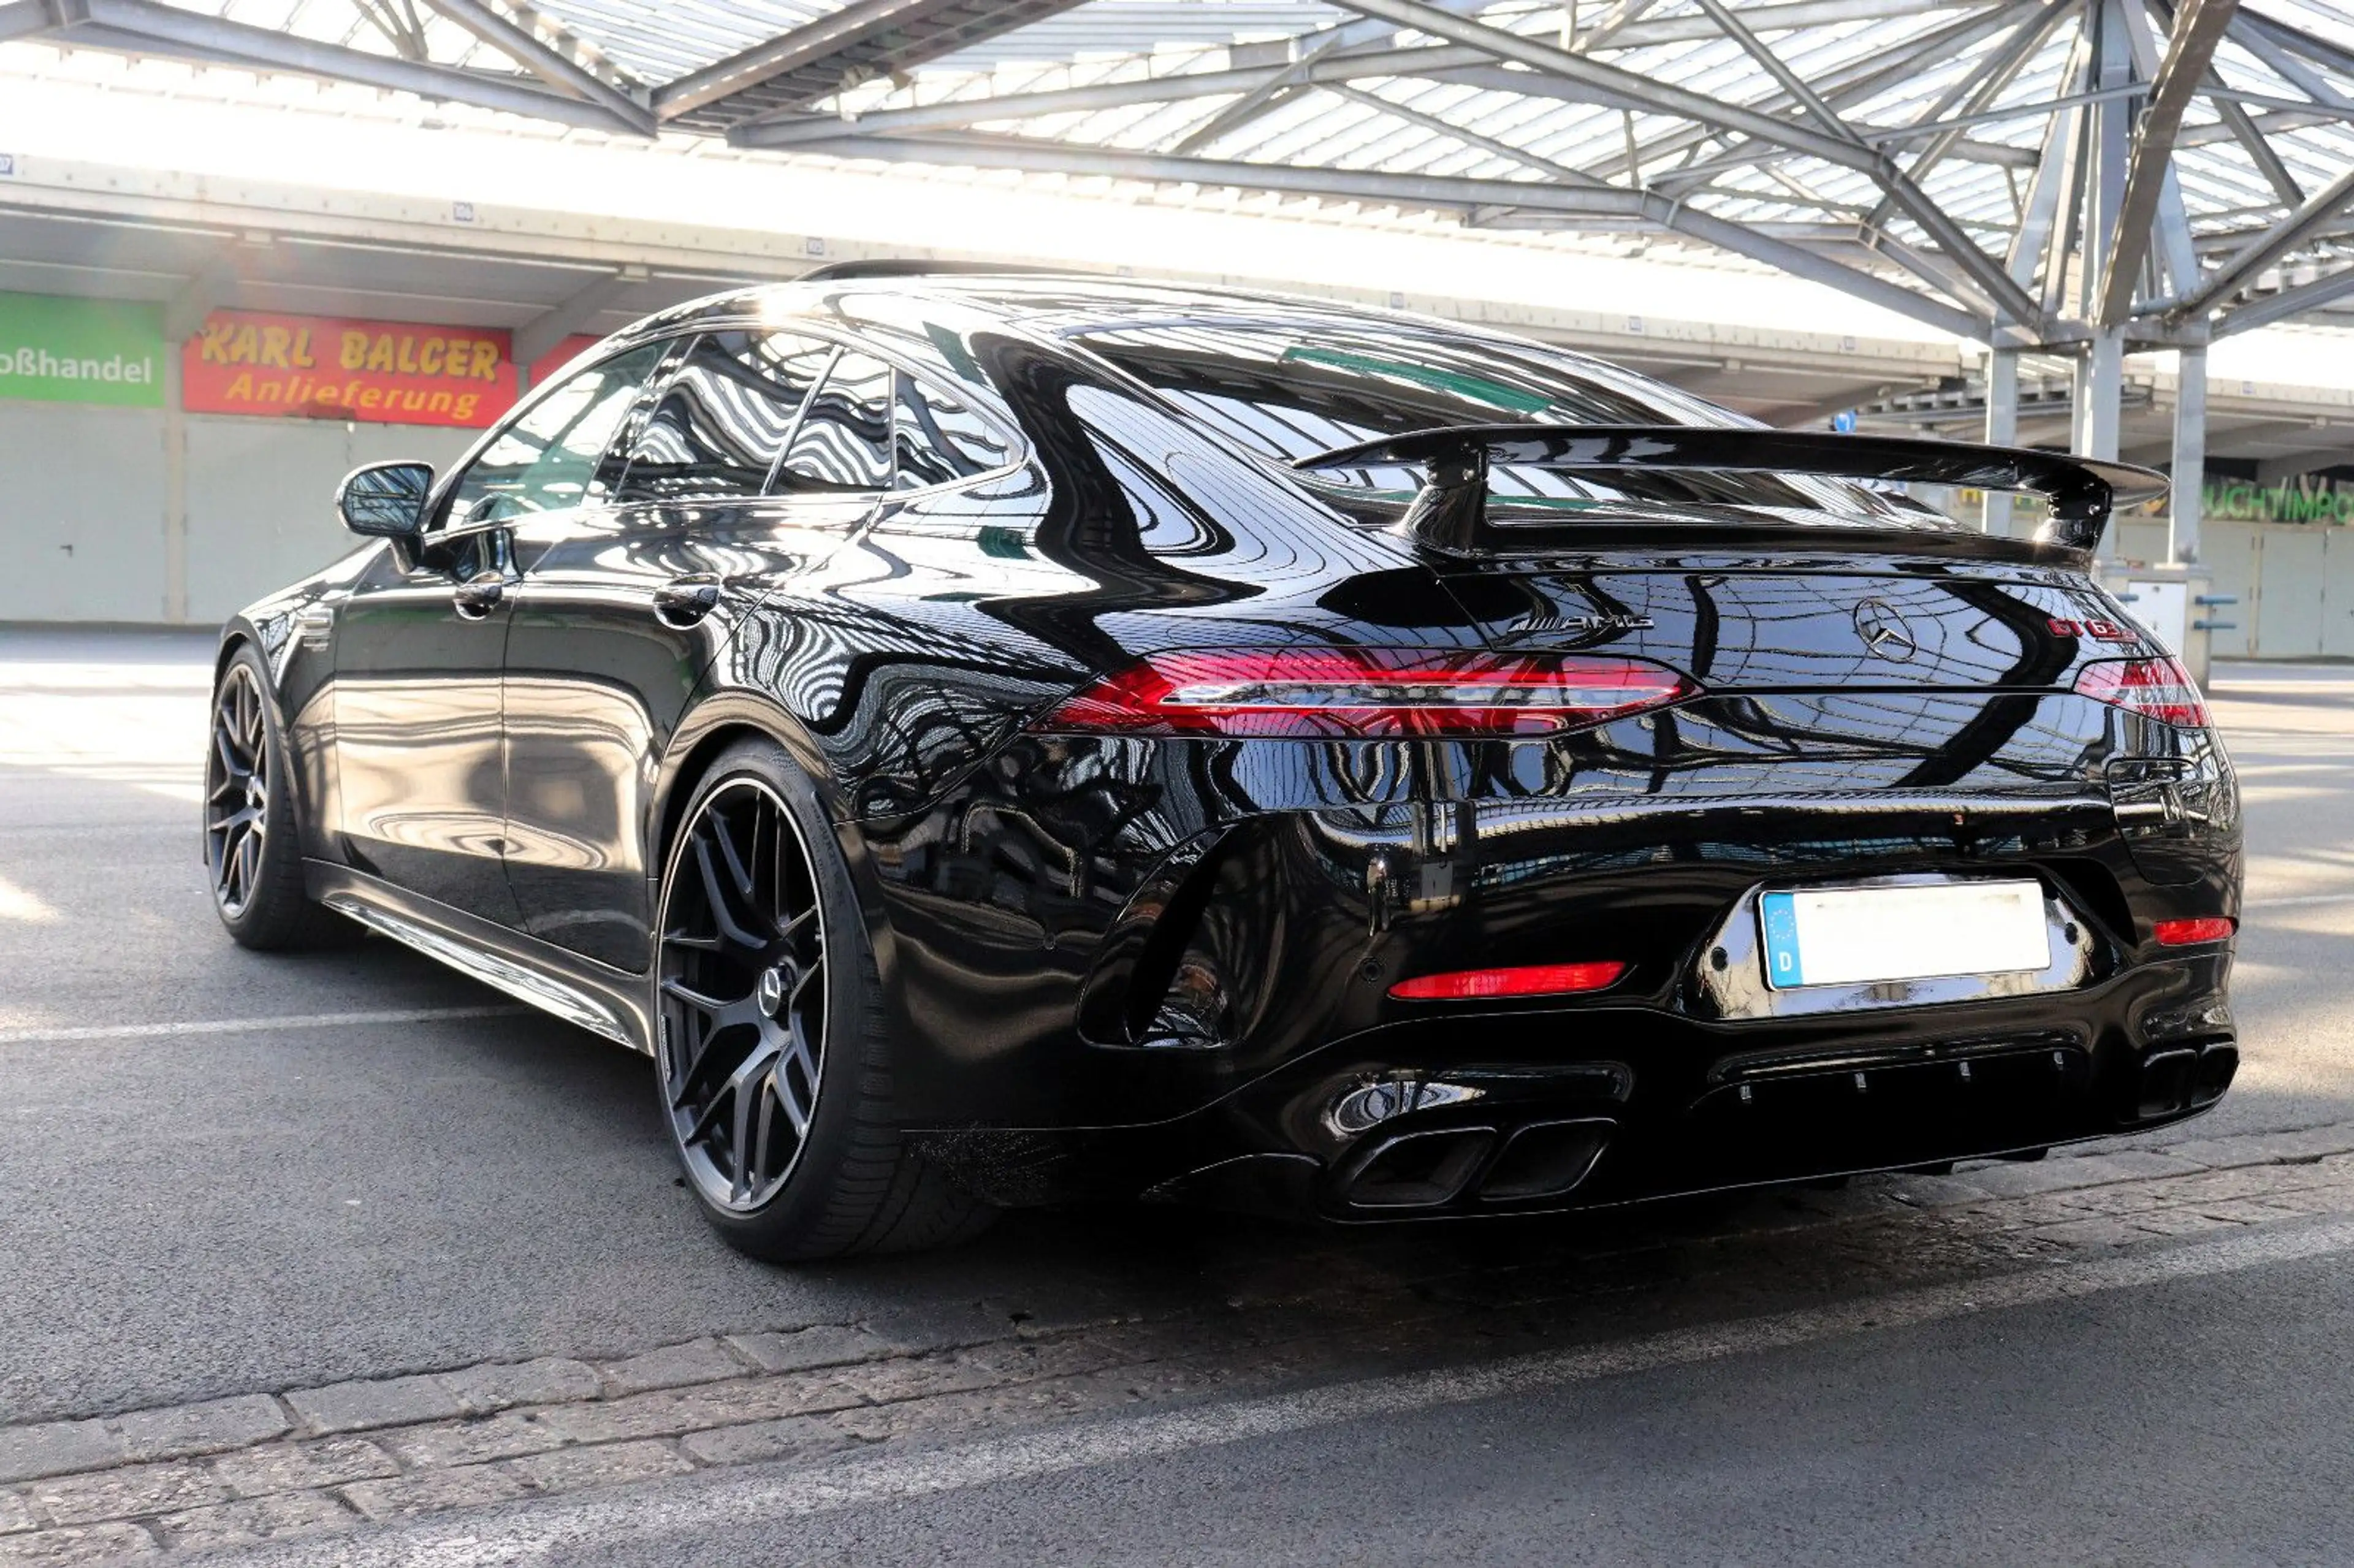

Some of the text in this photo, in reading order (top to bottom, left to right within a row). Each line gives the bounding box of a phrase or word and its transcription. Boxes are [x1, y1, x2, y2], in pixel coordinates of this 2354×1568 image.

[202, 322, 316, 369] KARL
[224, 372, 482, 421] Anlieferung
[1560, 614, 1655, 629] AMG
[1779, 951, 1792, 972] D
